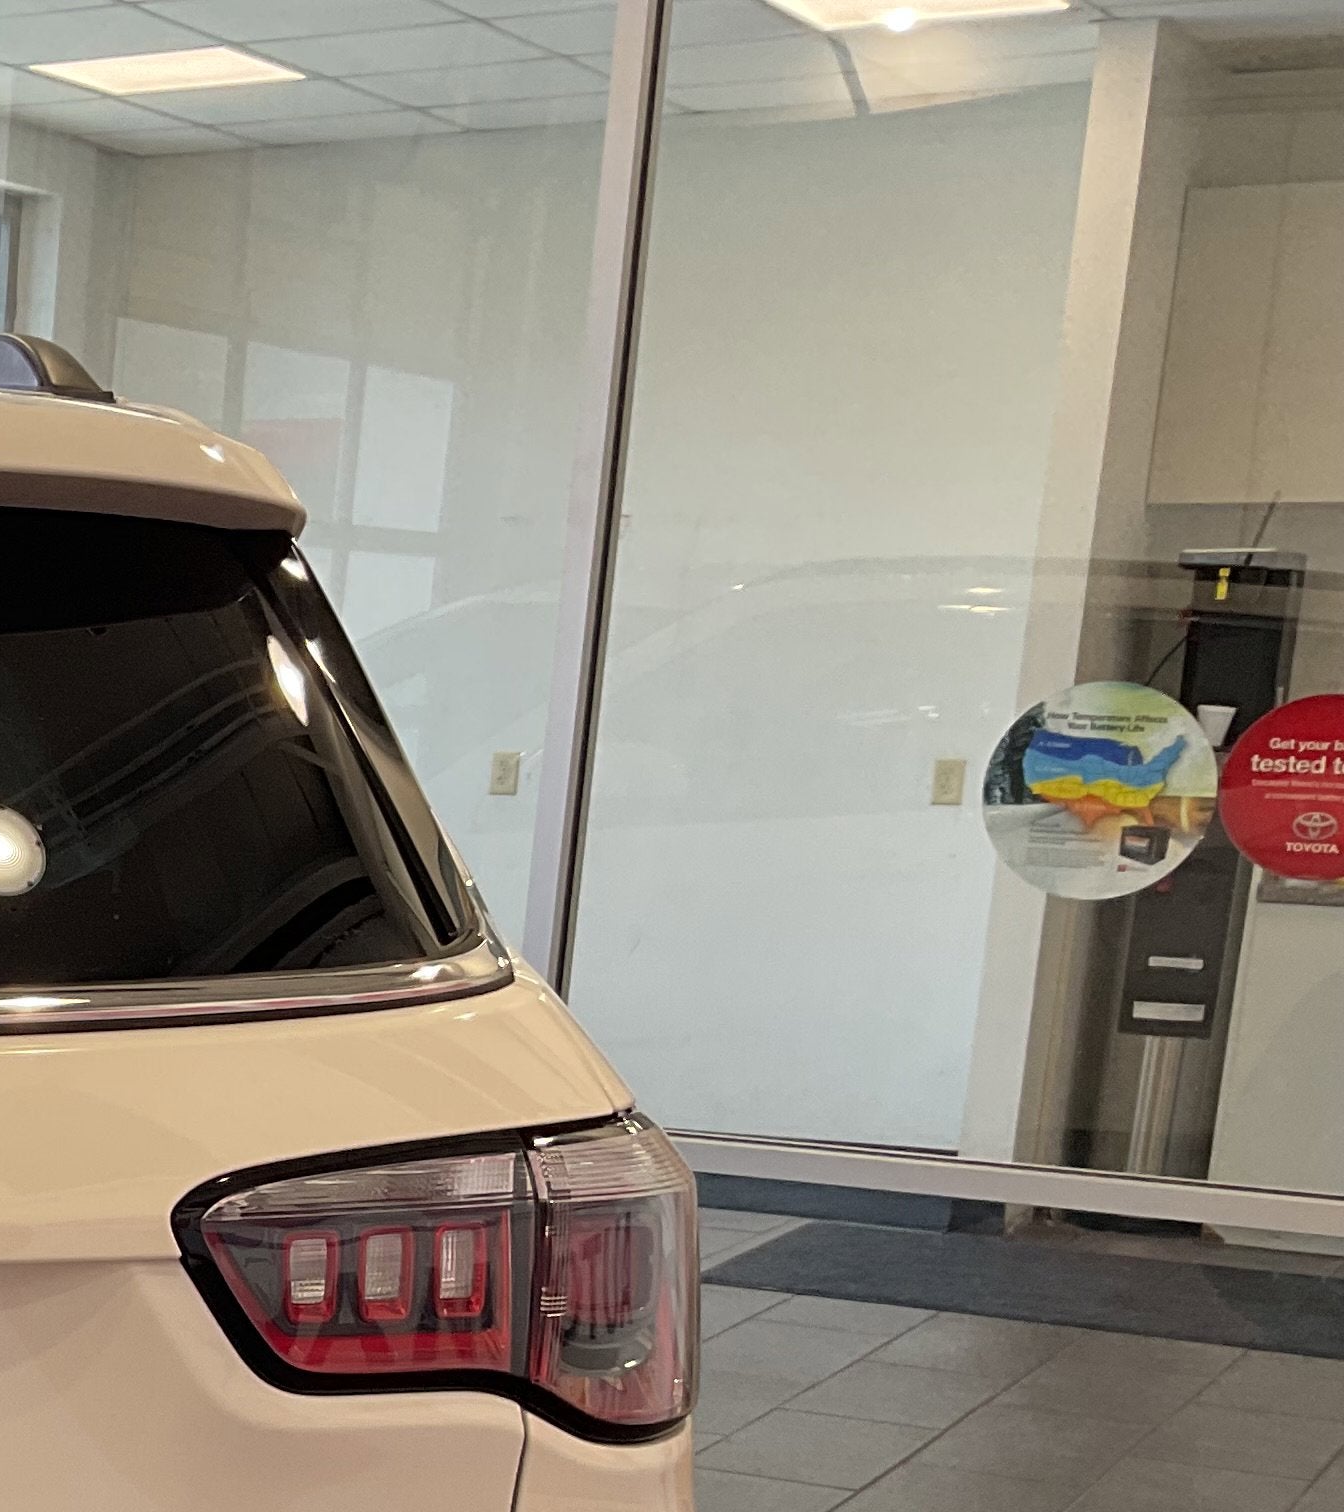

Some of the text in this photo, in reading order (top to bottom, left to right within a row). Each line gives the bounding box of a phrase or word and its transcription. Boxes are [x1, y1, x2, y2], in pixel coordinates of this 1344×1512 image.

[1268, 737, 1295, 751] Get
[1298, 741, 1331, 753] your
[1250, 754, 1326, 775] tested
[1285, 842, 1340, 855] TOYOTA
